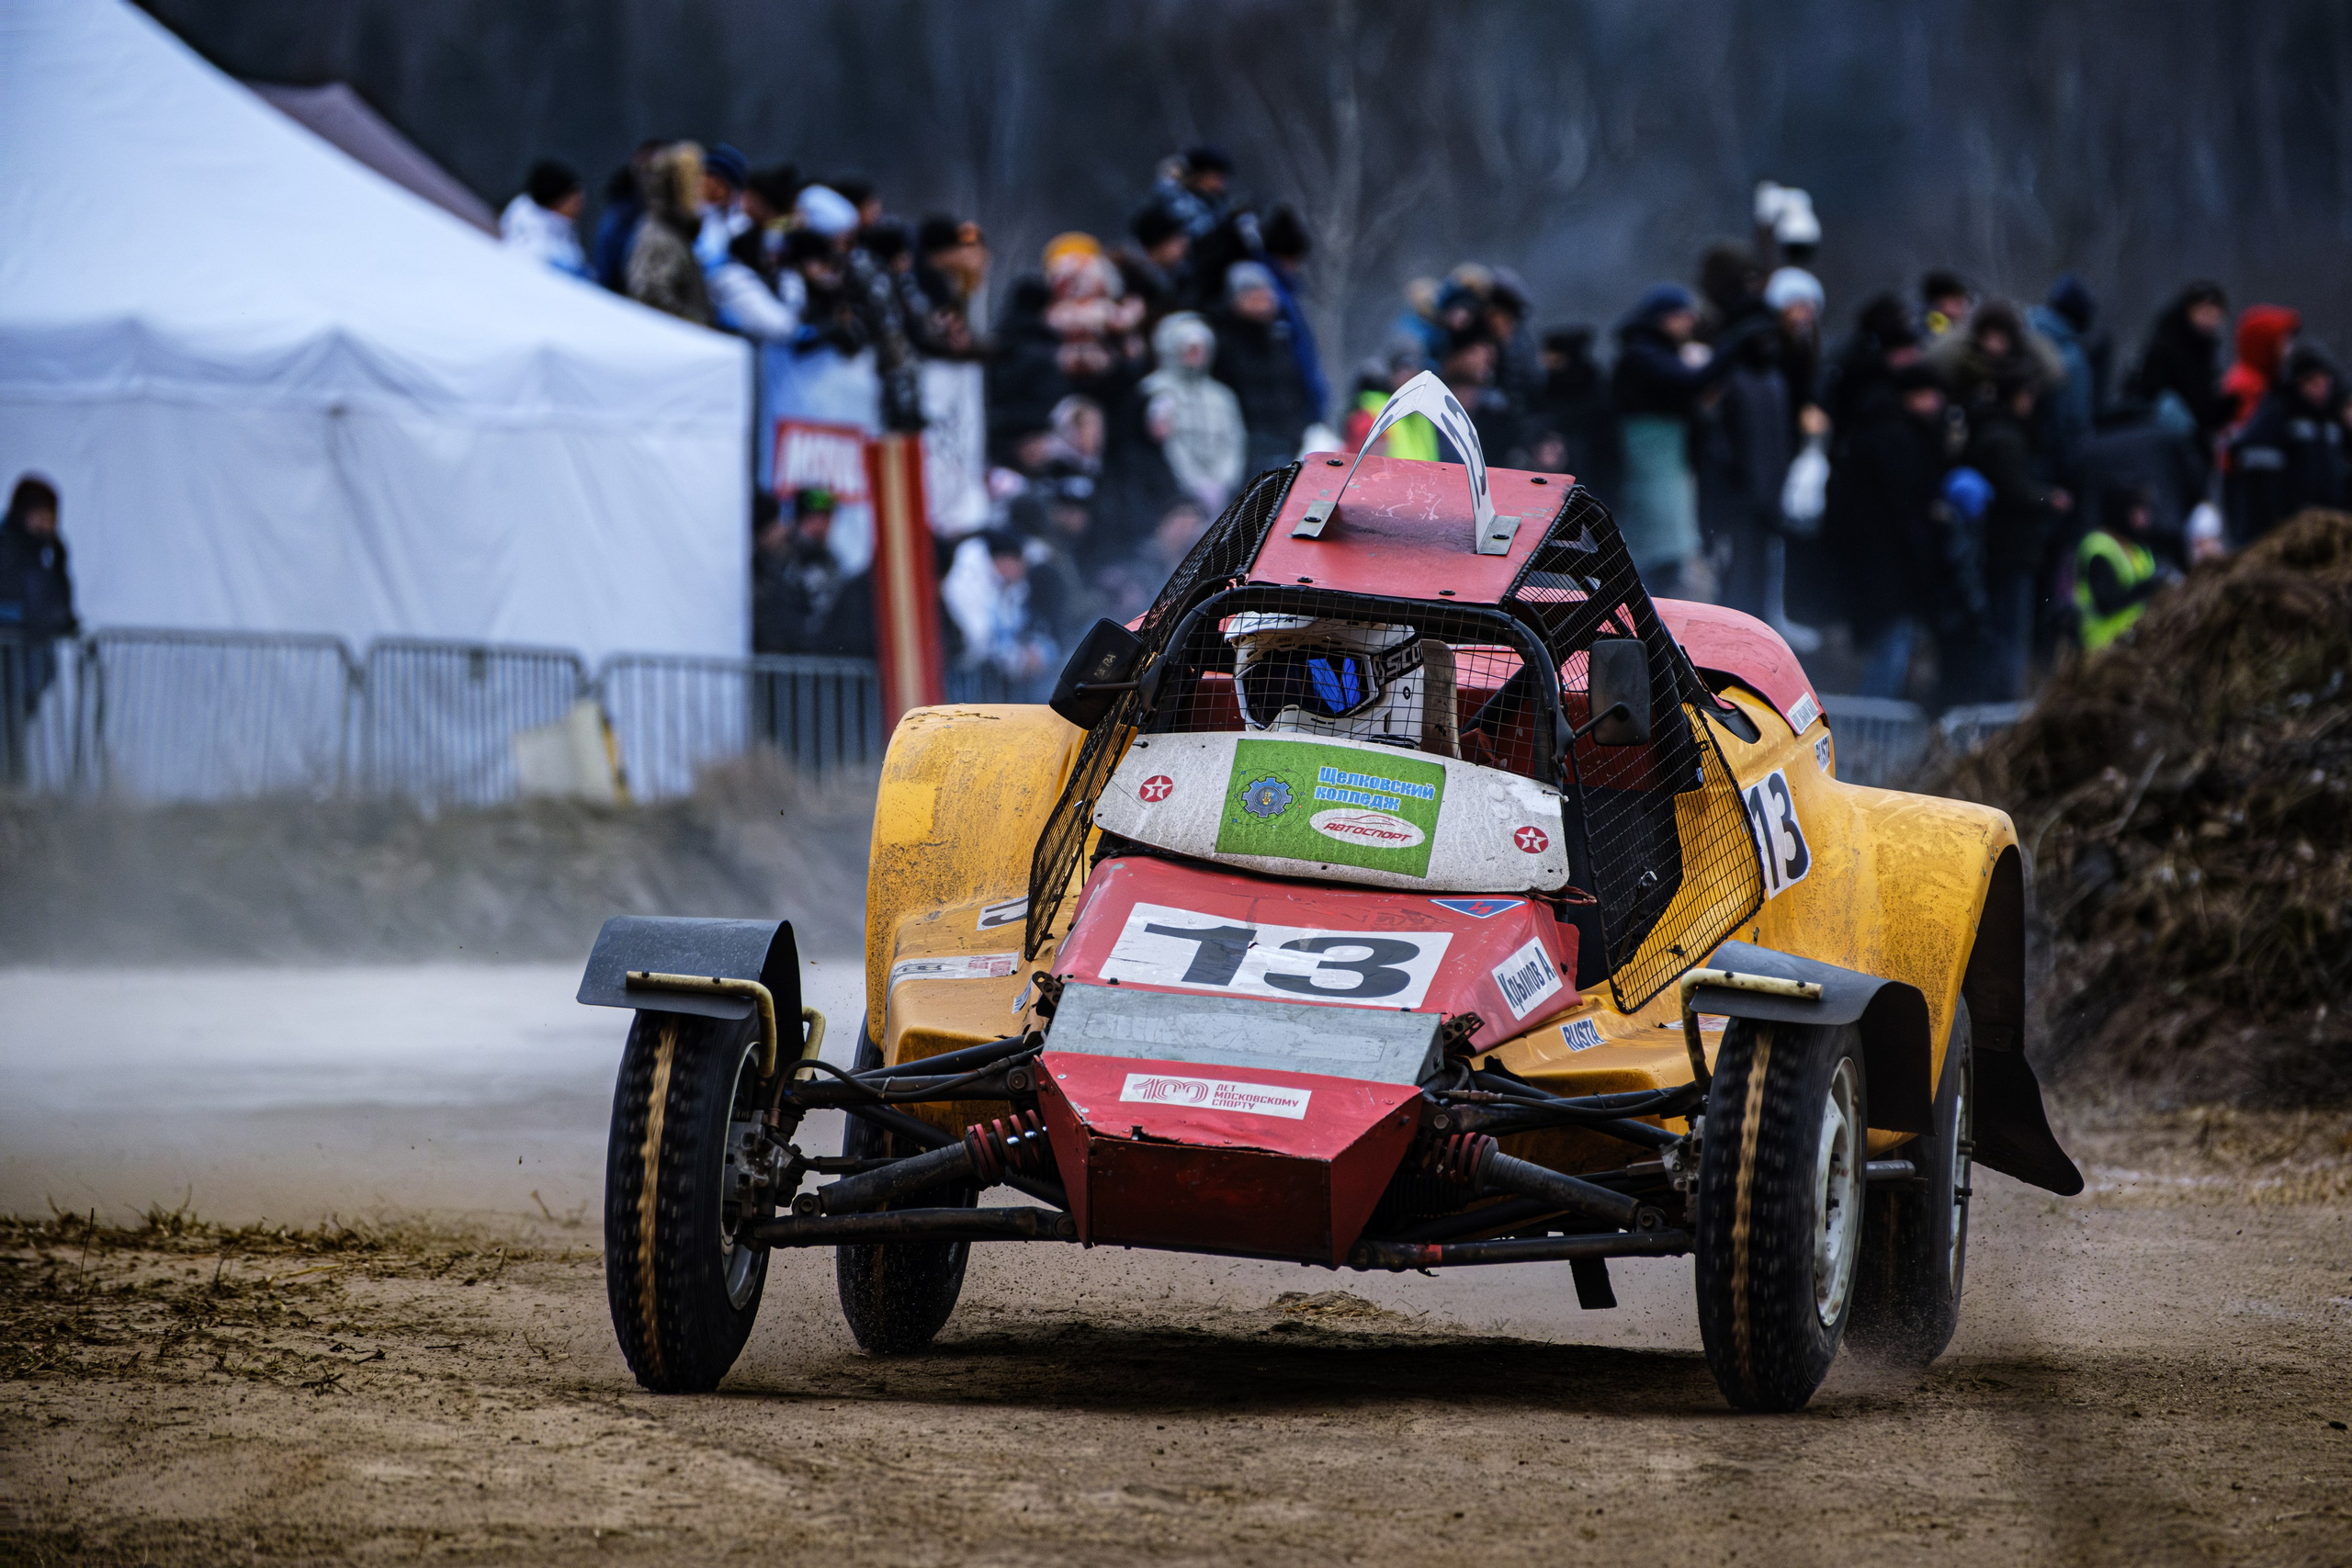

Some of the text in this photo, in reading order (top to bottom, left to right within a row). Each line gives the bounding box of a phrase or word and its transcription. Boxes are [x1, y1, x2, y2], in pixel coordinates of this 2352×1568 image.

[1385, 639, 1424, 677] SCO
[1317, 766, 1436, 800] Щелковский
[1314, 786, 1400, 811] колледж
[1323, 822, 1413, 842] АВТОСПОРТ
[1749, 773, 1809, 890] 13
[1144, 923, 1420, 998] 13
[1498, 961, 1545, 1012] Крымов
[1562, 1019, 1606, 1052] RUSTA
[1132, 1077, 1209, 1103] 100
[1214, 1091, 1299, 1108] МОСКОВСКОМУ
[1216, 1083, 1237, 1092] ЛЕТ
[1211, 1099, 1256, 1111] СПОРТУ
